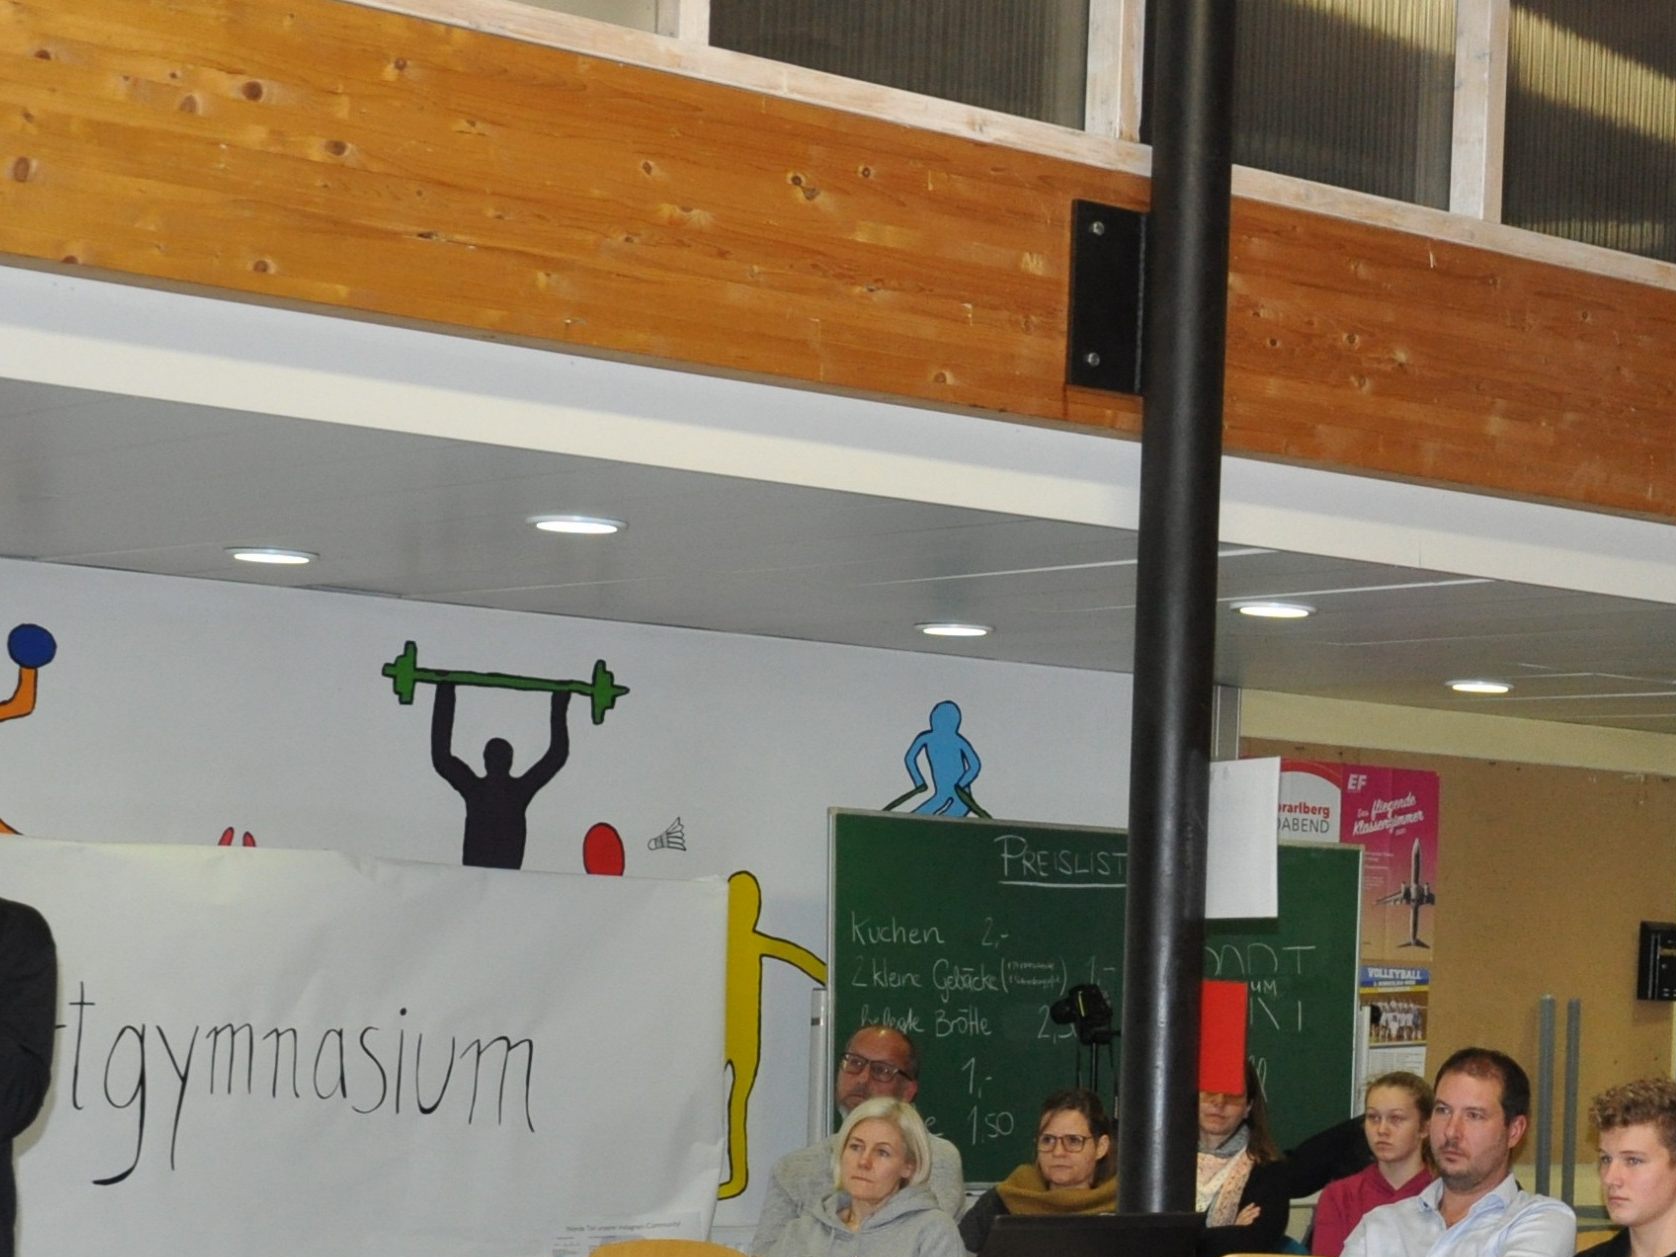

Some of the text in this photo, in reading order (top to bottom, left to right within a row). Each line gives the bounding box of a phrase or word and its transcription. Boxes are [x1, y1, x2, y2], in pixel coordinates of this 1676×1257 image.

[1347, 774, 1368, 790] EF
[1278, 801, 1331, 819] rarlberg
[851, 911, 945, 945] Kuchen
[55, 981, 535, 1186] tgymnasium
